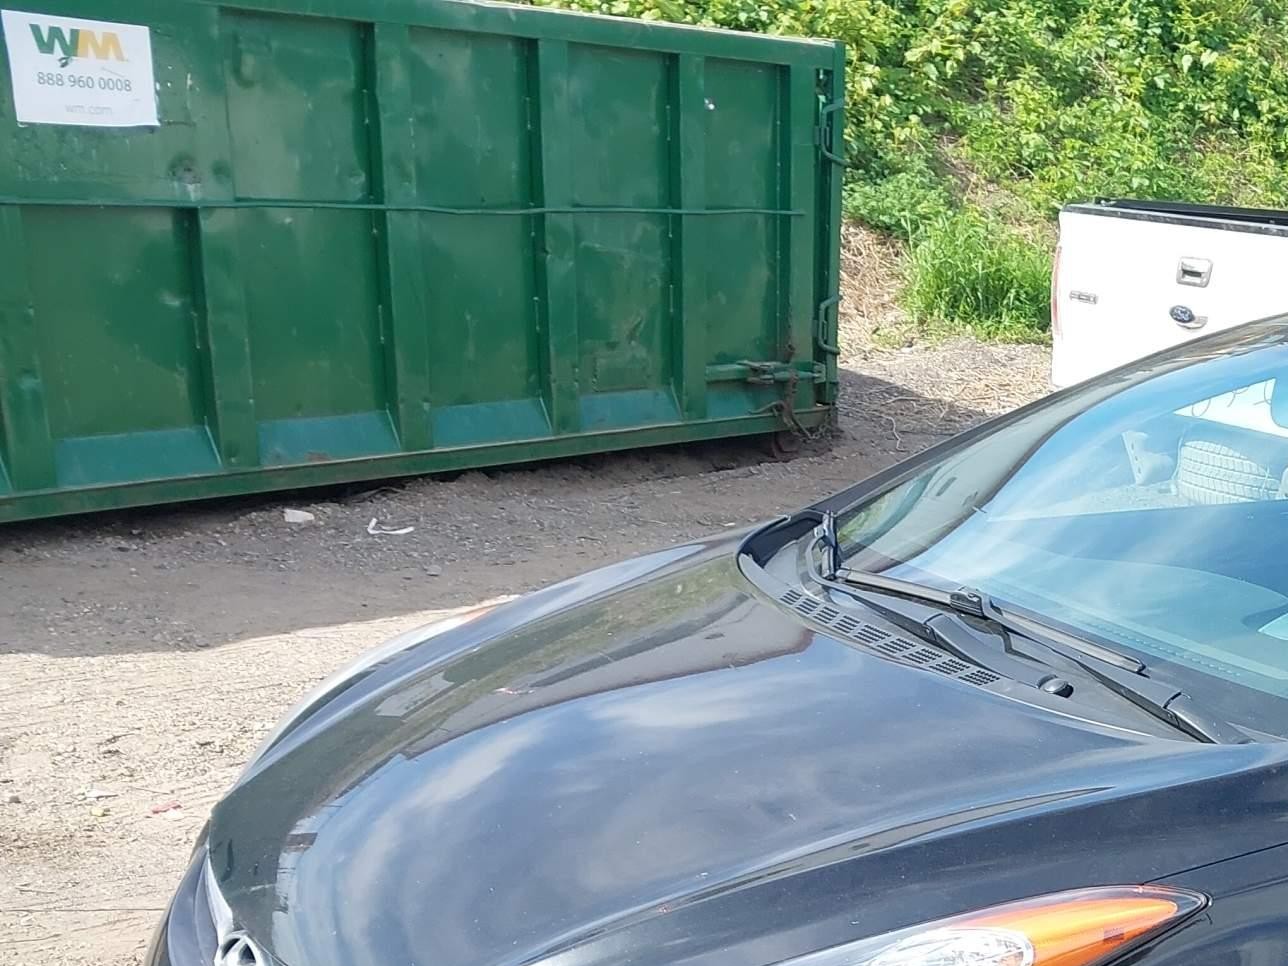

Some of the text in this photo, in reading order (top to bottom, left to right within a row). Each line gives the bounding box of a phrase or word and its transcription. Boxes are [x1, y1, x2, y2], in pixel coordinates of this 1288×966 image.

[28, 23, 126, 62] WM
[37, 71, 132, 92] 888 960 0008
[64, 103, 114, 117] wm.com
